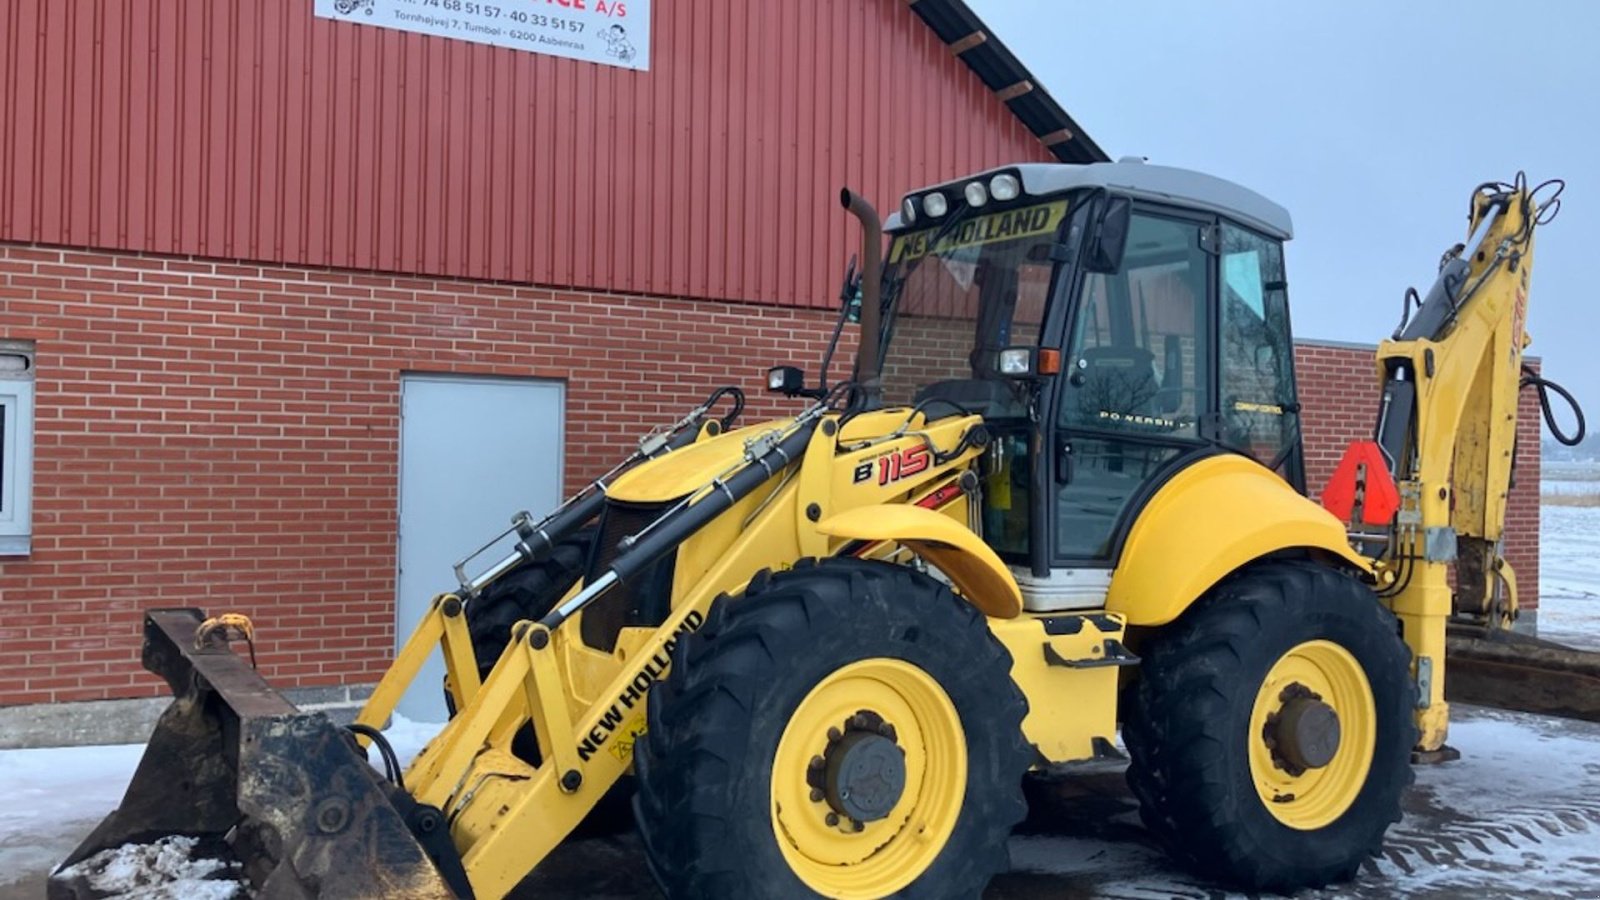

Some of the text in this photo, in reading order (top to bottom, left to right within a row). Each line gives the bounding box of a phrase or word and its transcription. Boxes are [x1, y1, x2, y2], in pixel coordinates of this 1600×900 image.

[443, 0, 461, 12] 68
[465, 2, 480, 15] 51
[484, 5, 501, 19] 57
[510, 11, 528, 23] 40
[531, 14, 548, 27] 33
[551, 18, 565, 30] 51
[569, 22, 585, 33] 57
[595, 0, 627, 18] A/S
[509, 30, 537, 42] 6200
[853, 462, 873, 484] B
[878, 444, 929, 486] 115
[577, 705, 624, 762] NEW
